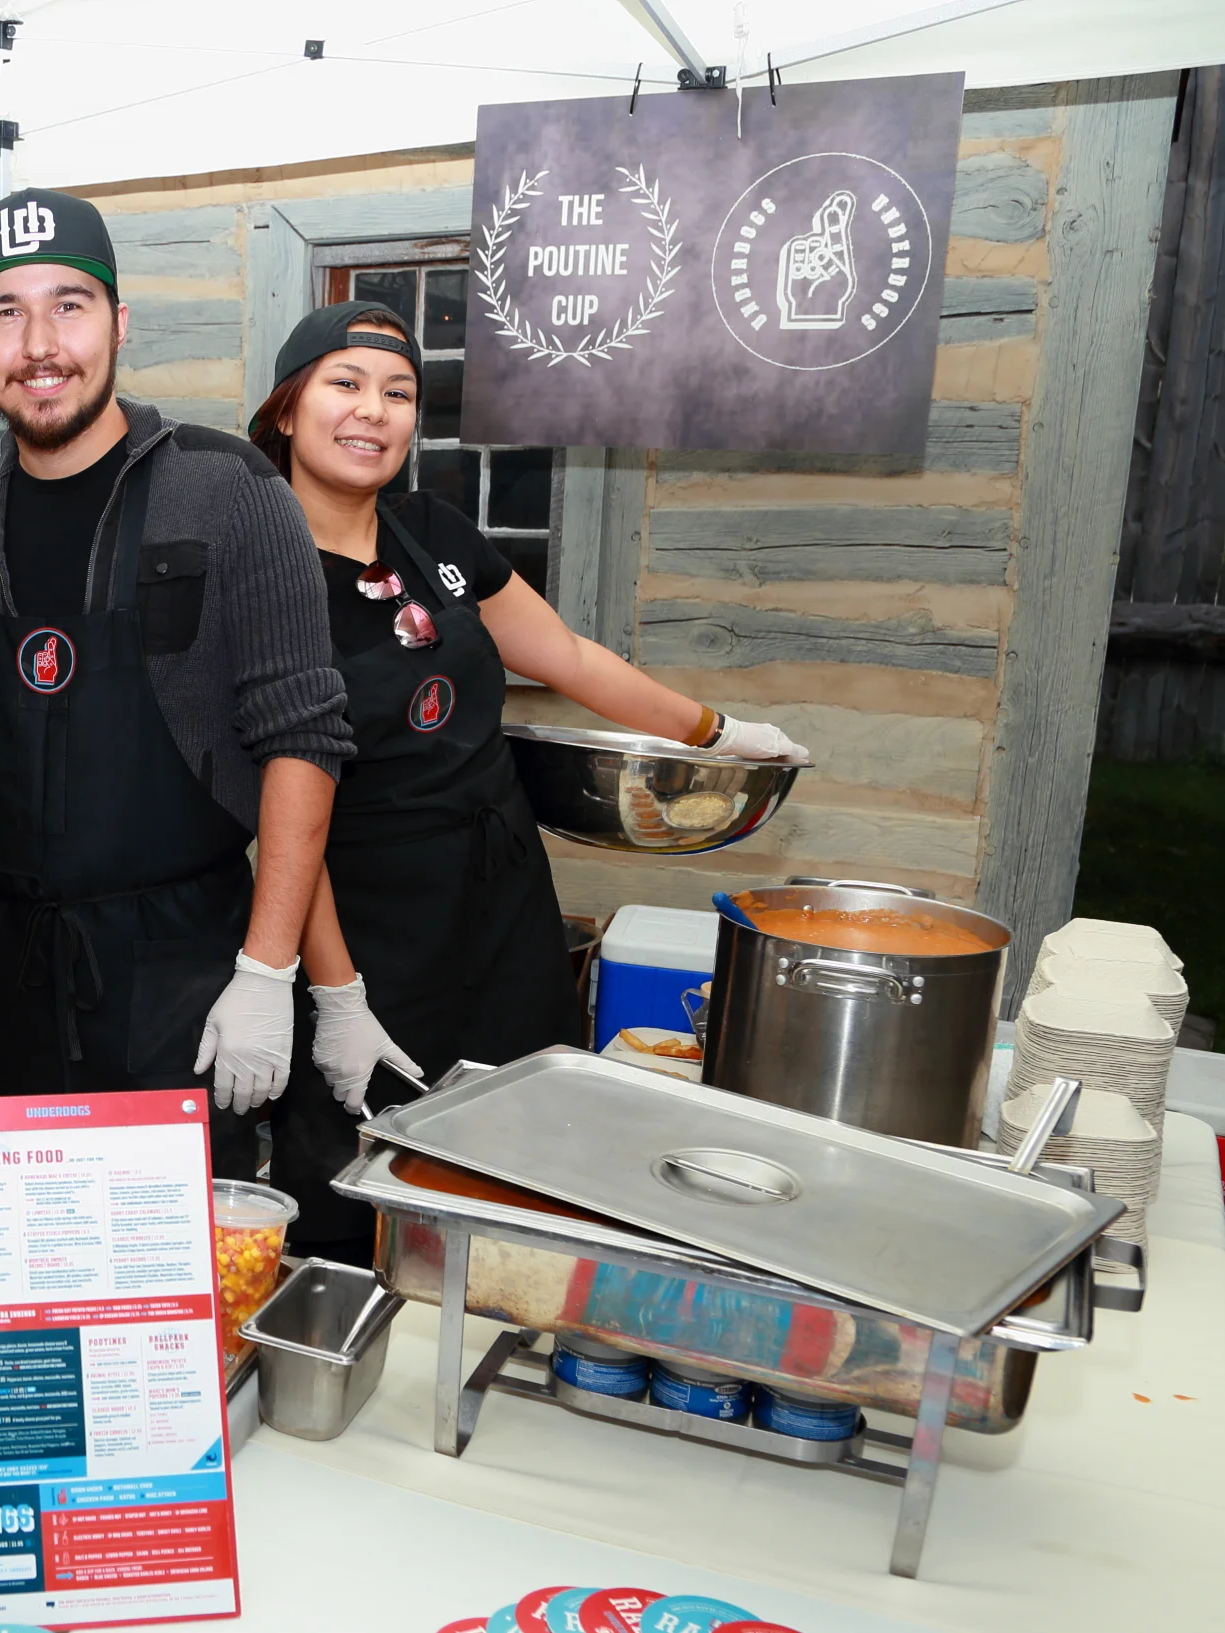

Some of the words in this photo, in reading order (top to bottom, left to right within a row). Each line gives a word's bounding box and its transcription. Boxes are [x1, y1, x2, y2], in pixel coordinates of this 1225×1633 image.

[558, 194, 604, 226] THE
[528, 243, 629, 277] POUTINE
[731, 198, 777, 332] UNDERDOGS
[860, 193, 910, 332] UNDERDOGS
[551, 294, 599, 326] CUP
[25, 1105, 90, 1118] UNDERDOGS
[26, 1149, 63, 1163] FOOD
[148, 1333, 189, 1343] BALLPARK
[154, 1342, 185, 1351] SNACKS
